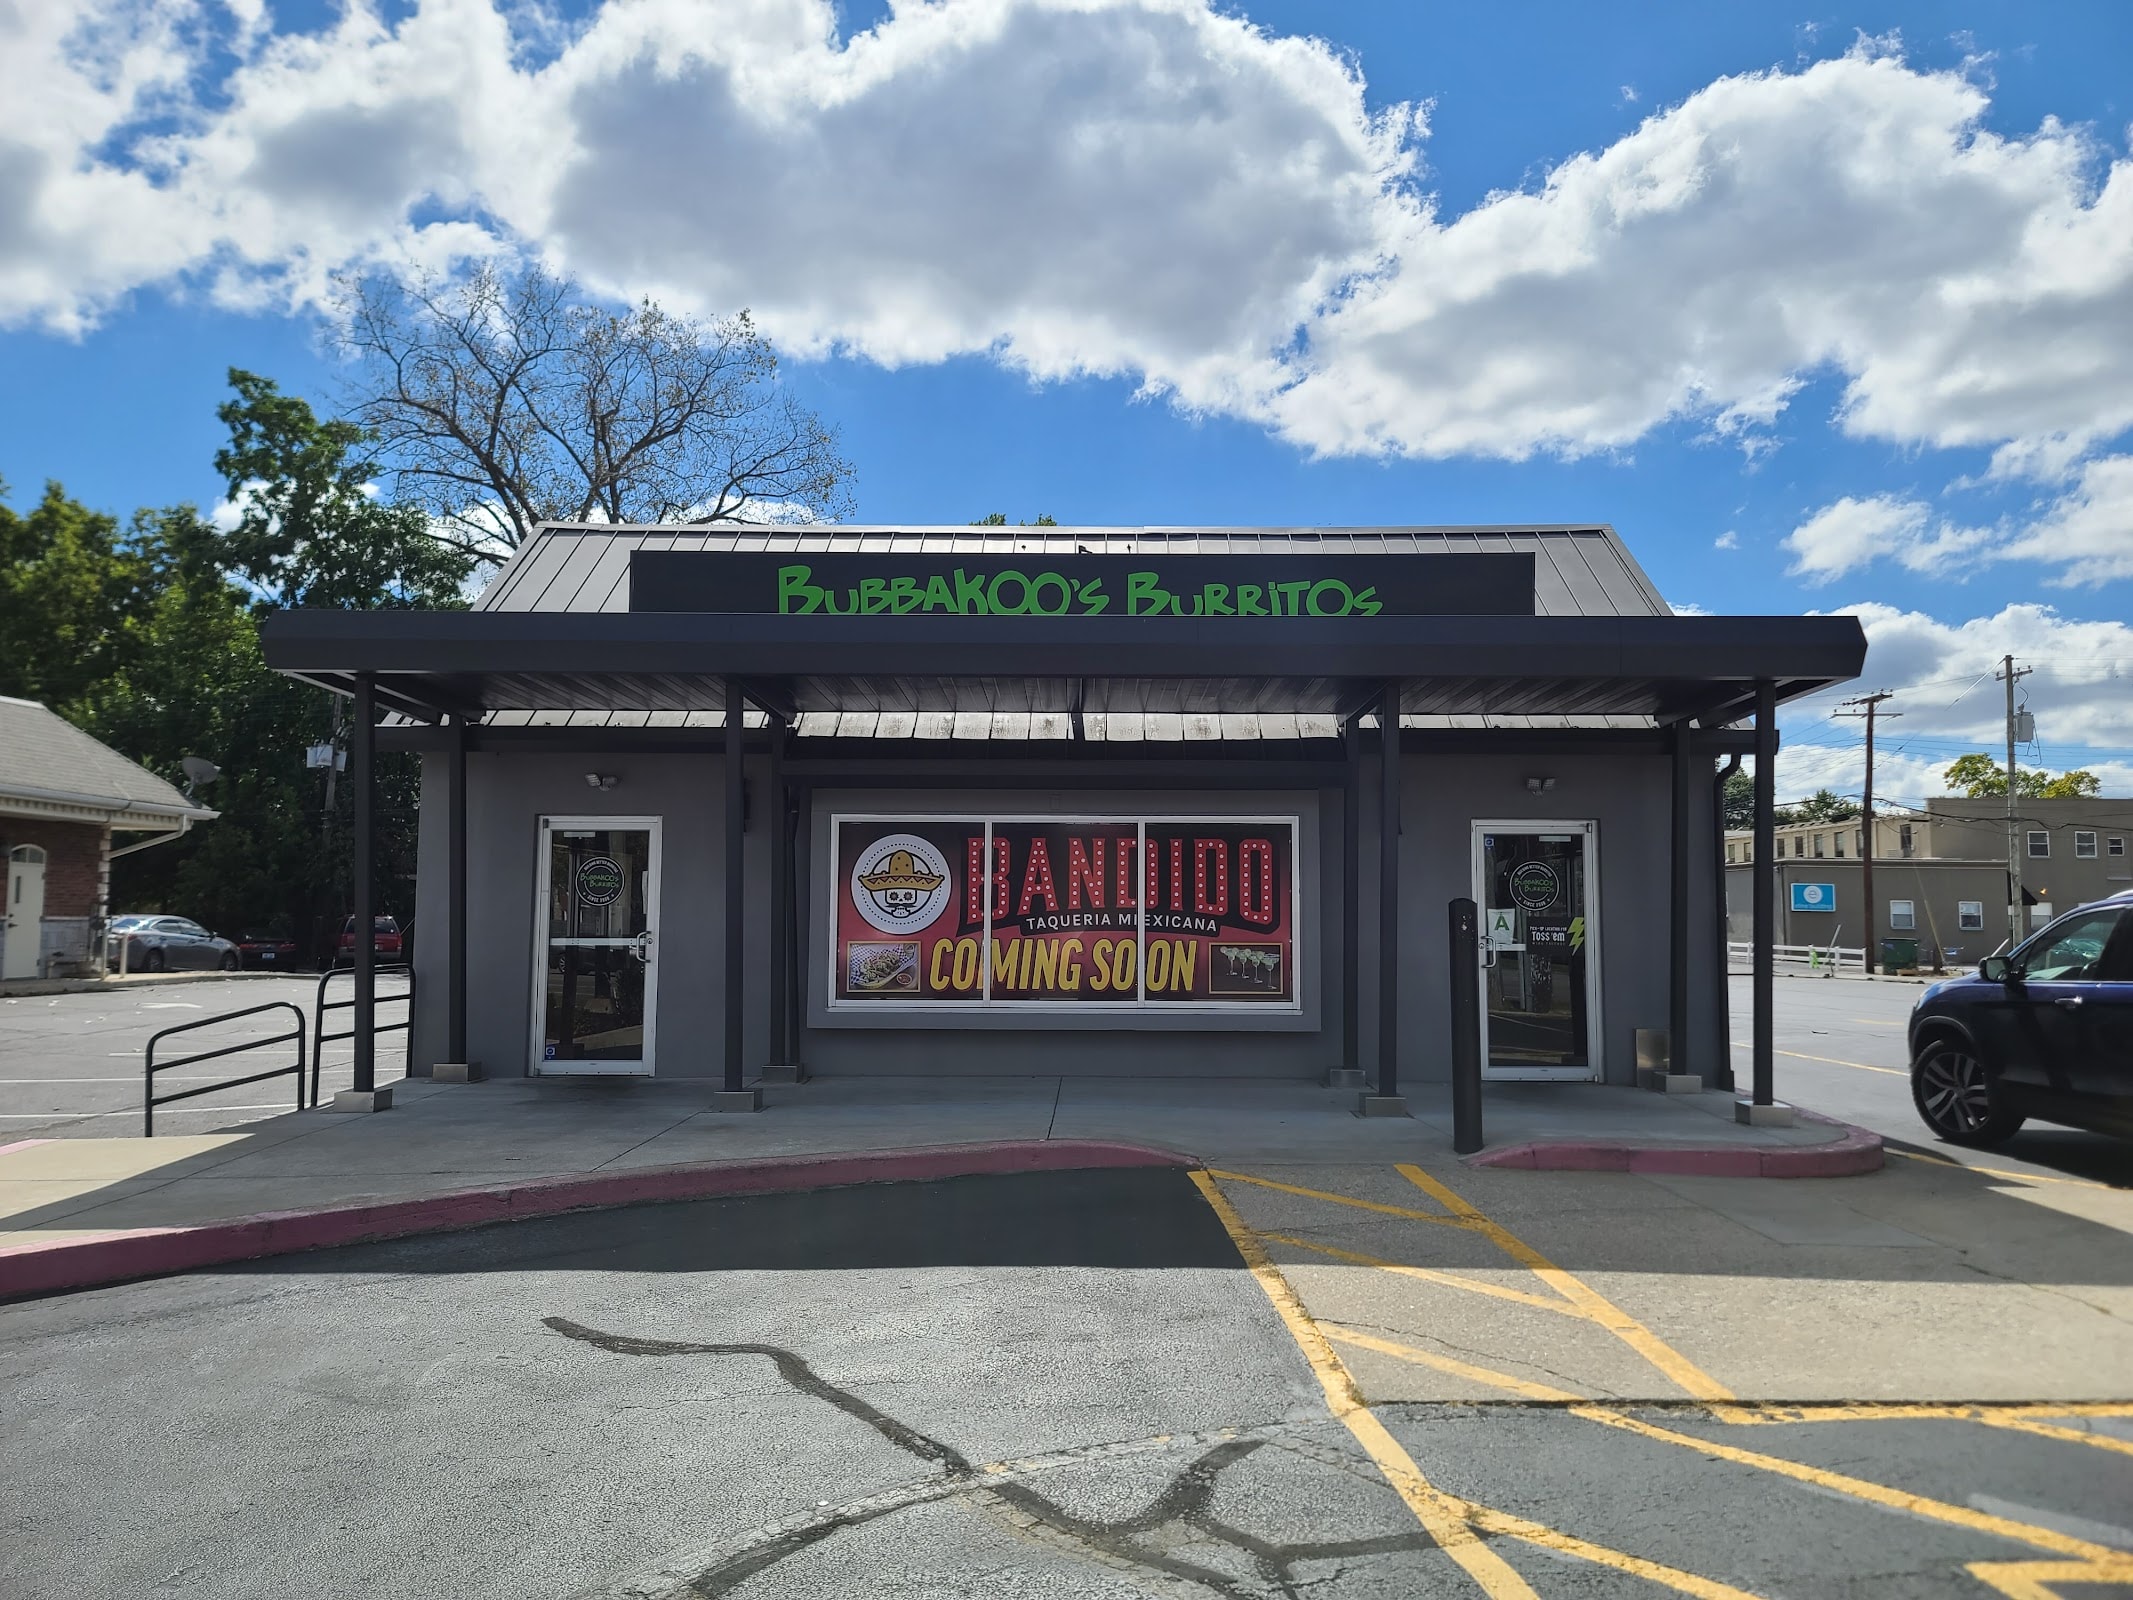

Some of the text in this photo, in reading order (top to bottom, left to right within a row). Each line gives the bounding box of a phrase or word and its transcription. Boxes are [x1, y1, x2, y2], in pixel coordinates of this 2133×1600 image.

[966, 837, 1280, 925] BANDIDO
[1026, 913, 1217, 932] TAQUERIA MEXICANA
[1494, 914, 1510, 930] A
[929, 938, 1197, 992] COMING SOON
